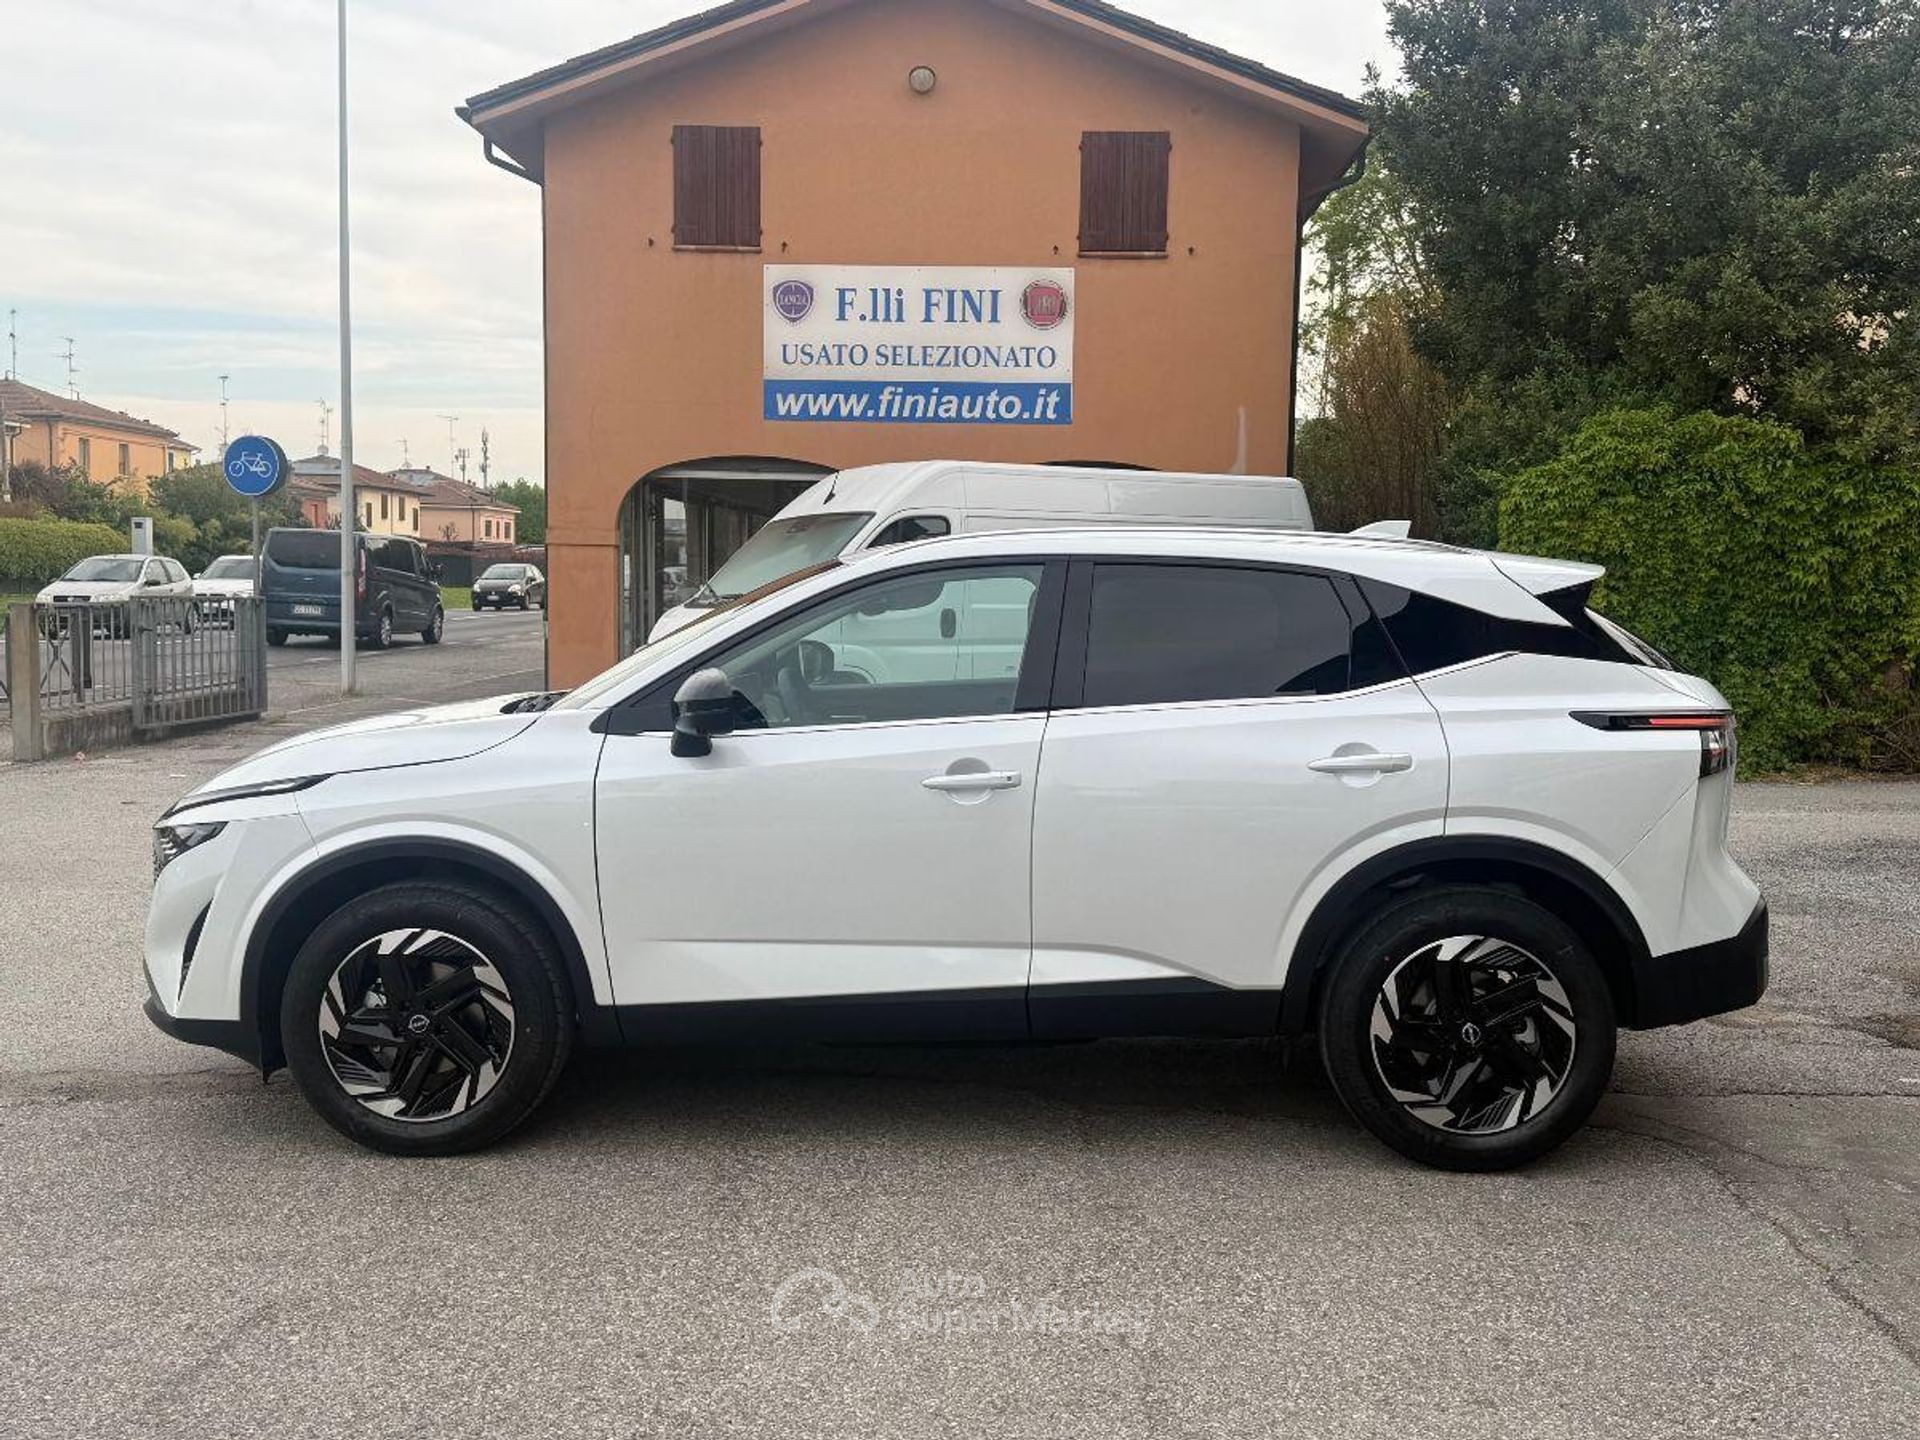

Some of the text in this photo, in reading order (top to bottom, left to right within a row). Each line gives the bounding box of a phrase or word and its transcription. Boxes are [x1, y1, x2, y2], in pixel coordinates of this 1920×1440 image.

[835, 287, 1003, 324] F.lli FINI
[781, 343, 1057, 369] USATO SELEZIONATO
[775, 385, 1061, 420] www.finiauto.it
